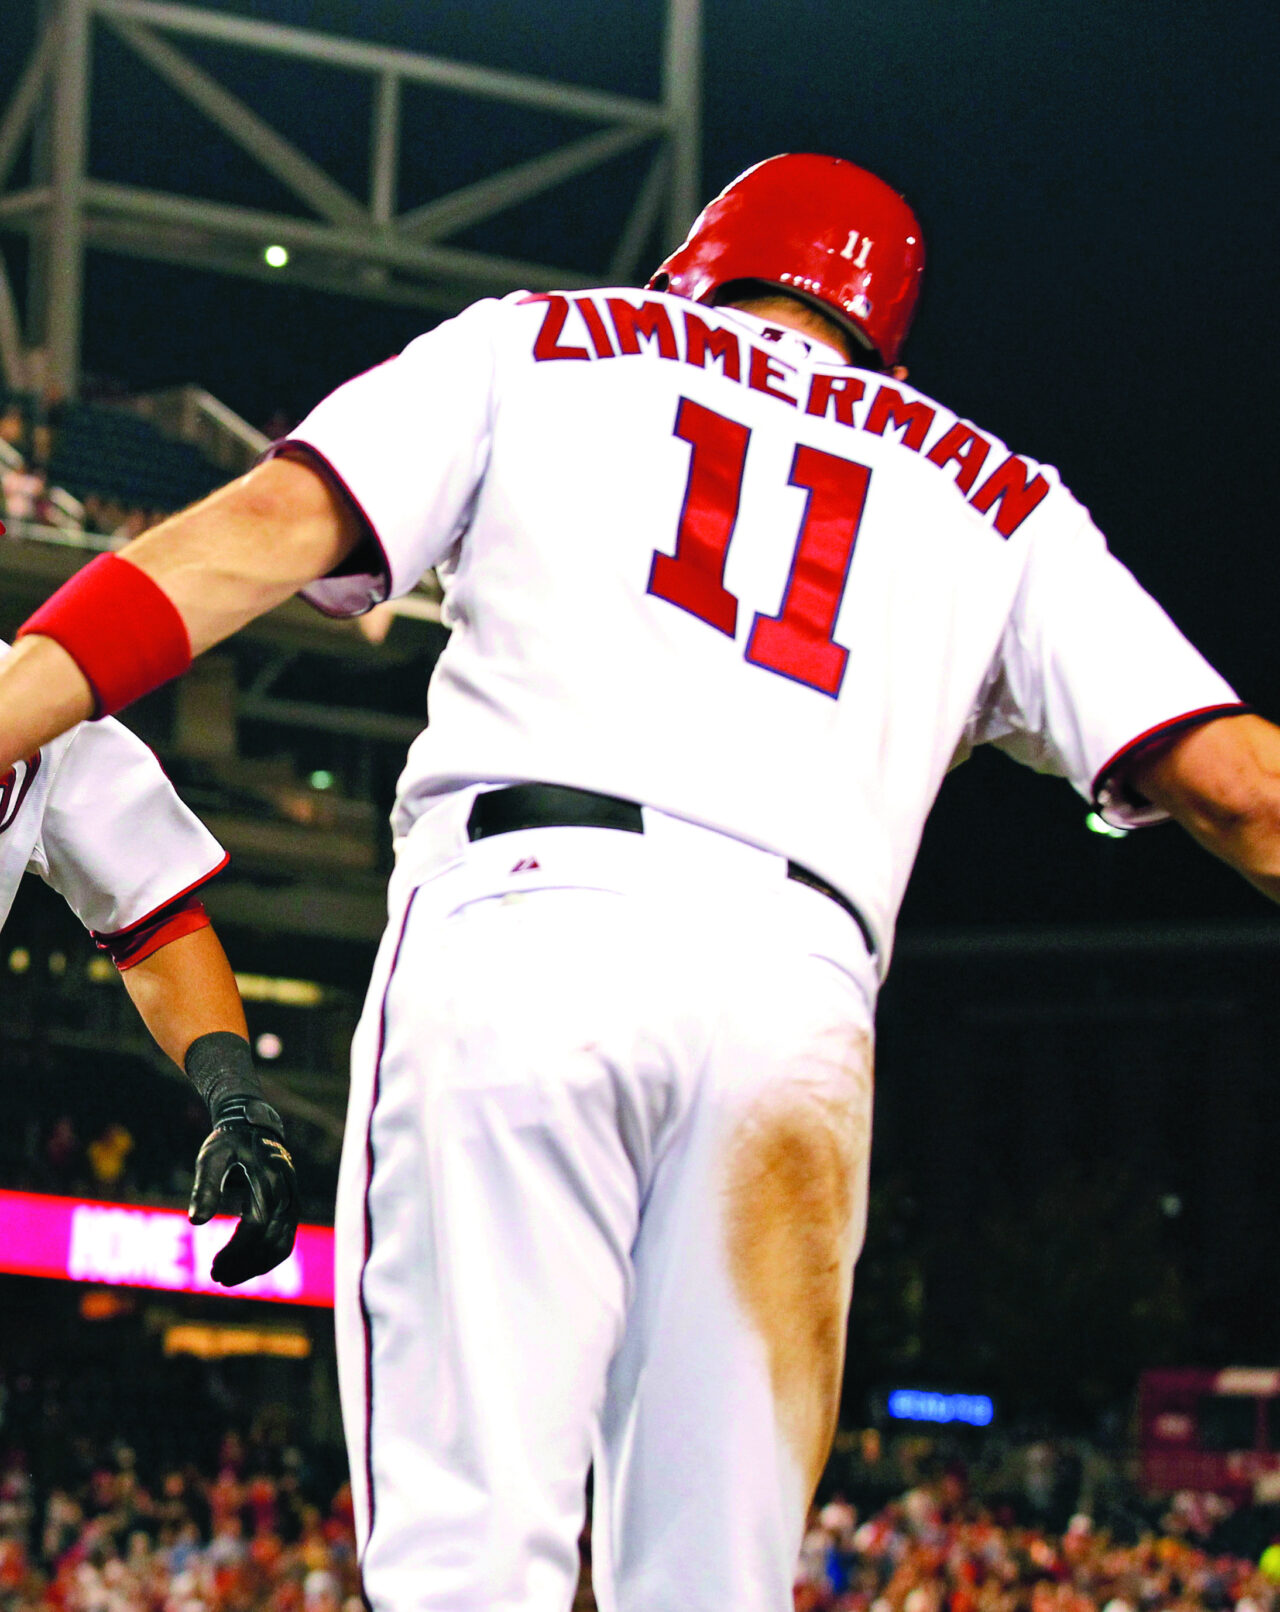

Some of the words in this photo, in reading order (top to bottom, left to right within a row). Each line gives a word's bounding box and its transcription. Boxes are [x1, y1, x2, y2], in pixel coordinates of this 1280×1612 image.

[840, 229, 874, 269] 11
[518, 294, 1050, 541] ZIMMERMAN
[645, 395, 872, 701] 11
